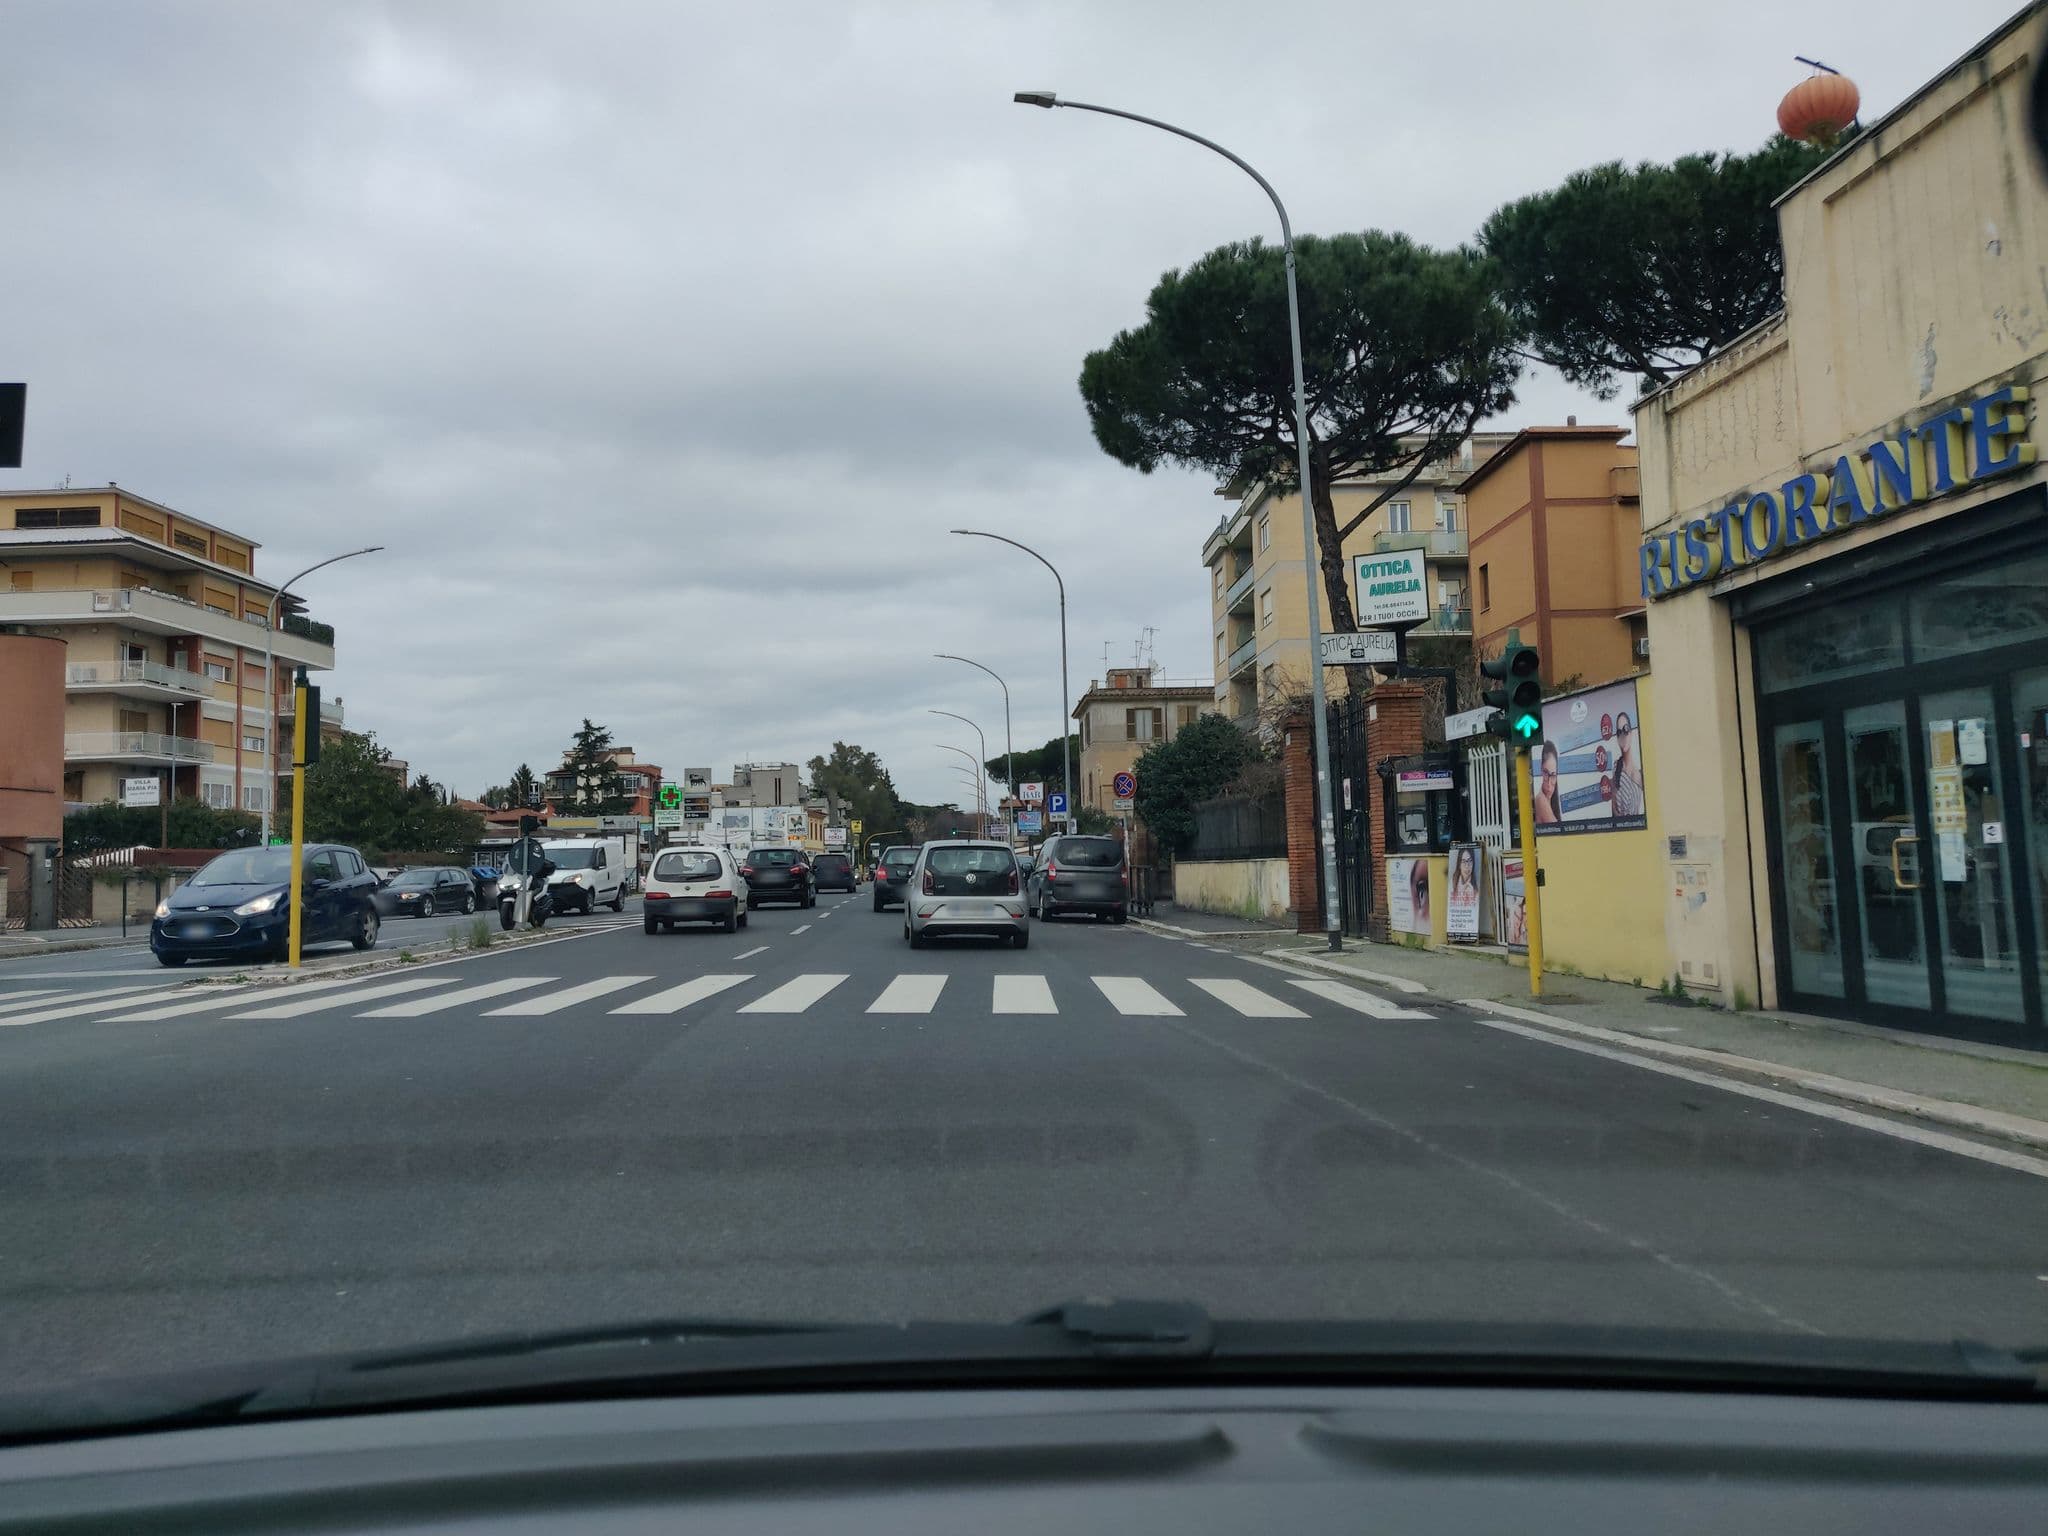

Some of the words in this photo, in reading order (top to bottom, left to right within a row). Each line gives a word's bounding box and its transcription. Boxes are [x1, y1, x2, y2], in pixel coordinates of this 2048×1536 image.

[1639, 386, 2037, 599] RISTORANTE
[1360, 559, 1412, 579] OTTICA
[1369, 578, 1421, 597] AURELIA
[1359, 613, 1373, 622] PER
[1378, 612, 1394, 621] TUOI
[1320, 635, 1354, 657] OTTICA
[1356, 634, 1396, 655] AURELIA
[1052, 795, 1064, 811] P
